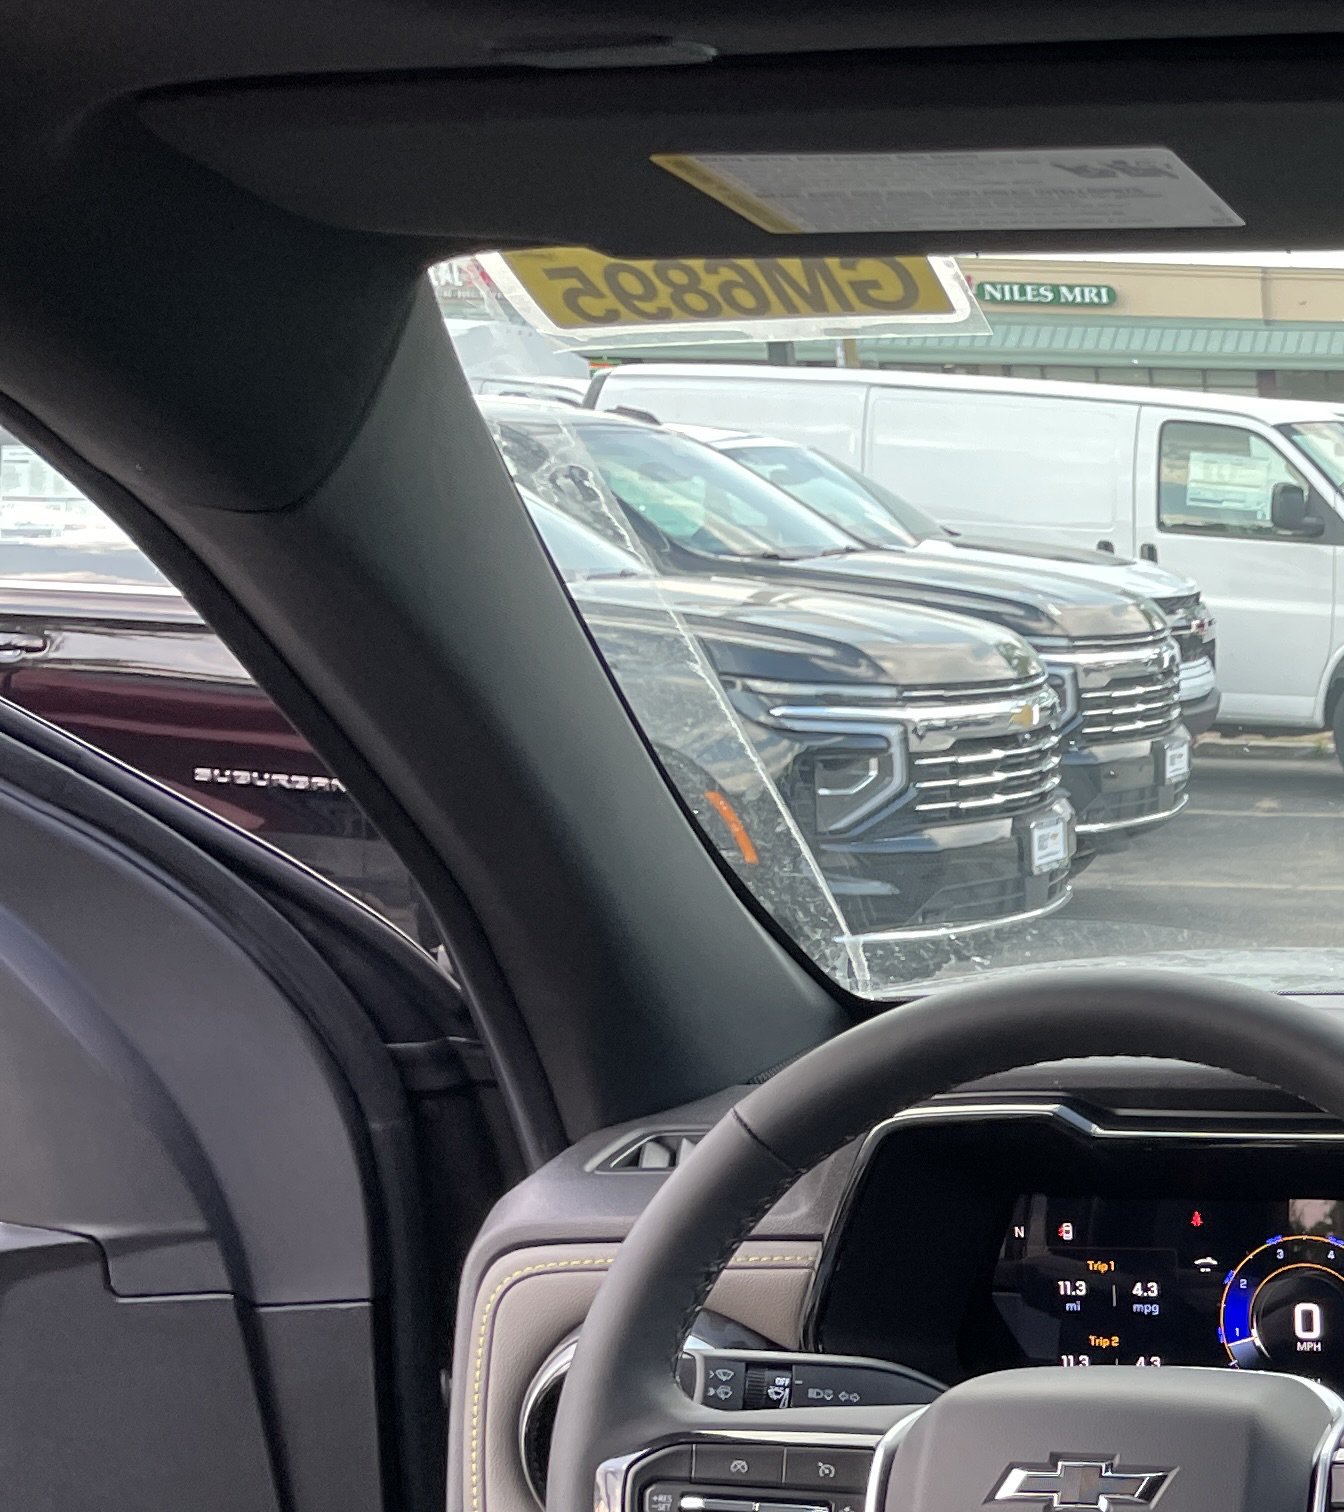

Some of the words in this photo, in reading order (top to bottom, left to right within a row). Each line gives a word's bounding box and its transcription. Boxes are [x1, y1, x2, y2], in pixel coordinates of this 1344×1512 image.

[983, 283, 1054, 302] NILES
[1060, 285, 1109, 305] MRI
[1014, 1226, 1025, 1238] N
[1276, 1249, 1285, 1260] 3
[1327, 1250, 1336, 1260] 4
[1087, 1260, 1109, 1274] Trip
[1110, 1261, 1115, 1271] 1
[1057, 1280, 1087, 1296] 11.3
[1239, 1278, 1248, 1288] 2
[1132, 1282, 1159, 1297] 4.3
[1065, 1301, 1081, 1311] mi
[1132, 1304, 1160, 1316] mpg
[1294, 1303, 1321, 1339] 0
[1235, 1328, 1240, 1337] 1
[1088, 1335, 1110, 1348] Trip
[1111, 1336, 1120, 1347] 2
[1297, 1342, 1322, 1352] MPH
